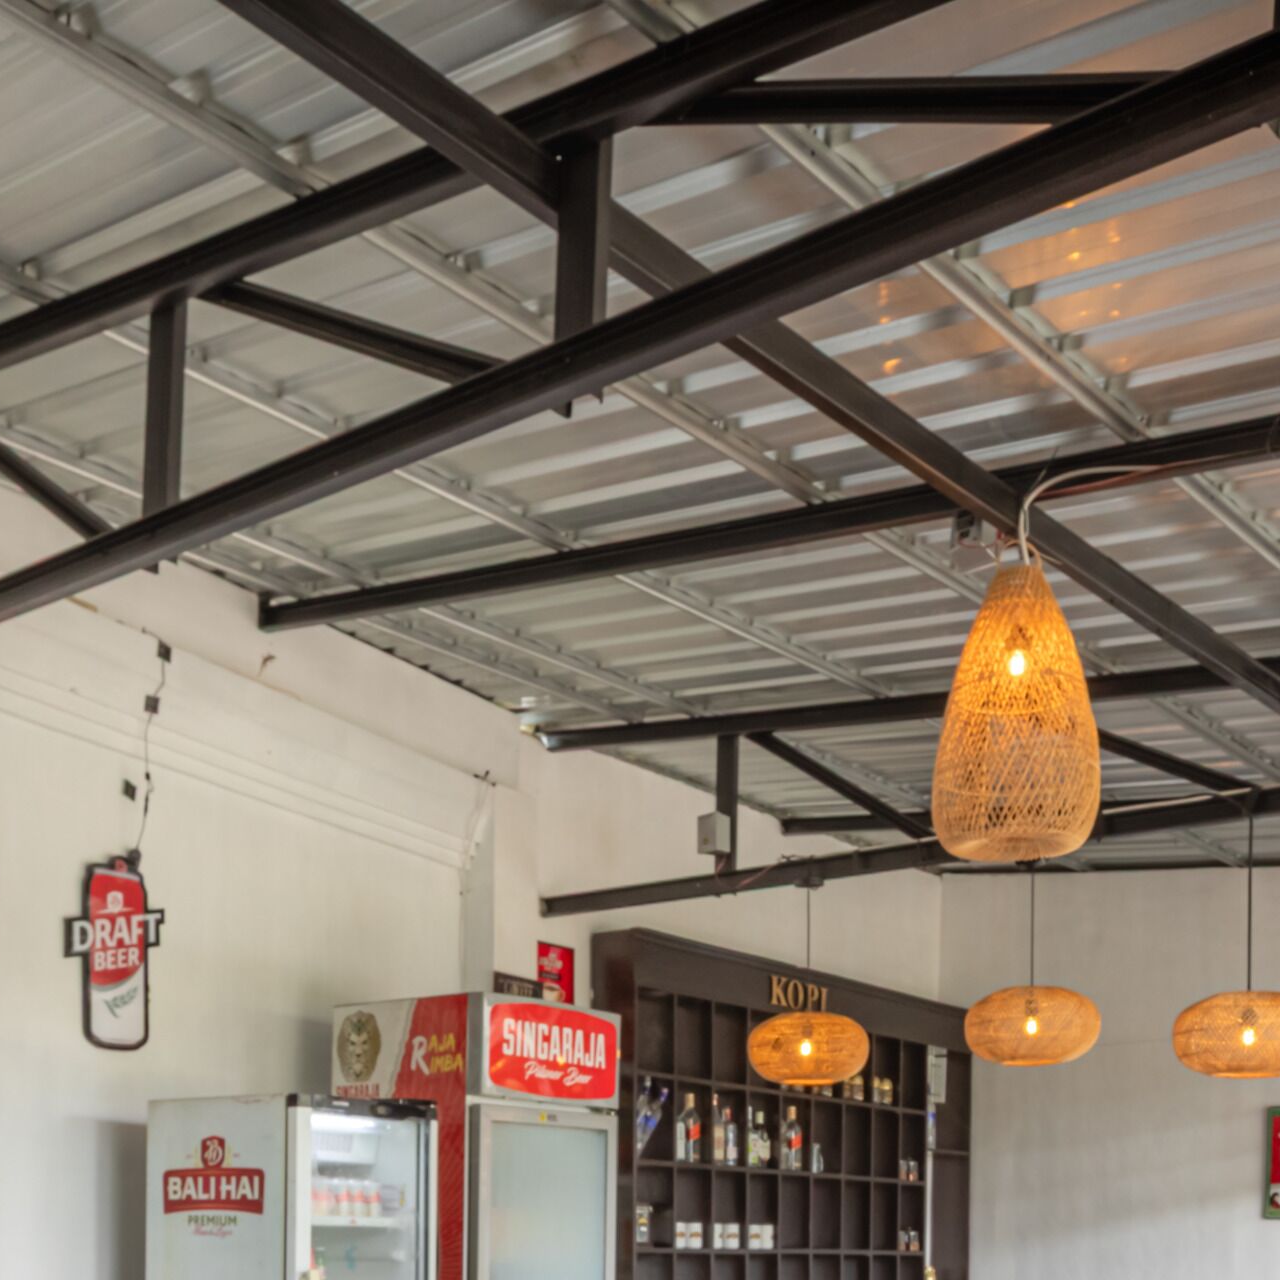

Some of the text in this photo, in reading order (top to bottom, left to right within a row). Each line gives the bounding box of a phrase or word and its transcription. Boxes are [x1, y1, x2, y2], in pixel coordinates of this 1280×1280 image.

[71, 912, 163, 954] DRAFT
[94, 947, 140, 972] BEER
[770, 975, 828, 1011] KOPI
[502, 1017, 606, 1070] SINGARAJA
[524, 1060, 593, 1086] Pilsner Beer
[167, 1176, 259, 1200] BALI HAI
